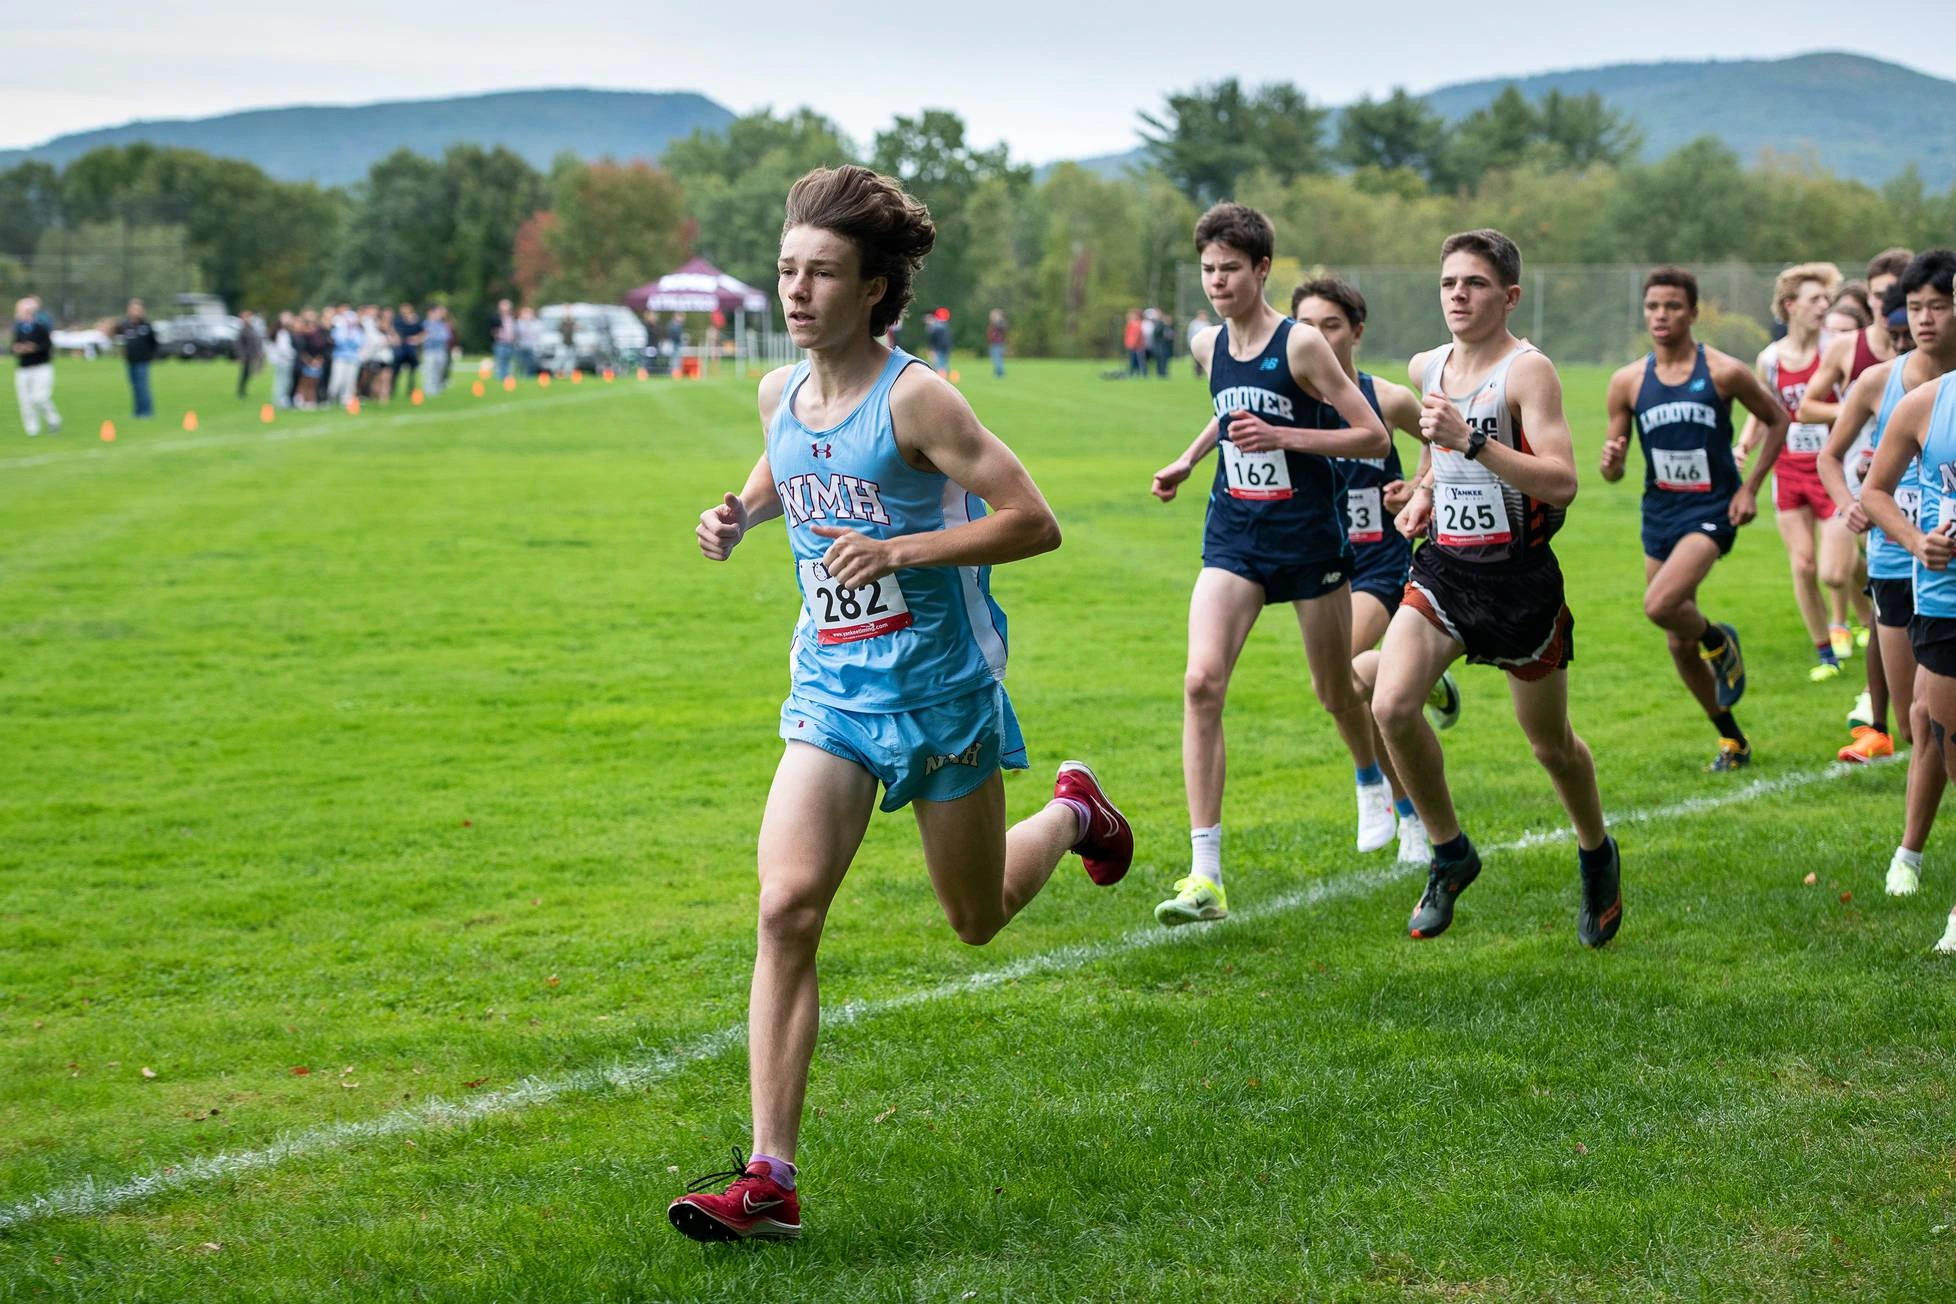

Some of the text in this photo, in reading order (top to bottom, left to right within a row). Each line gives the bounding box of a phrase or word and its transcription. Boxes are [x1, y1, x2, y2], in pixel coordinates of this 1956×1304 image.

[1235, 462, 1279, 486] 162
[1664, 464, 1701, 480] 146
[779, 473, 891, 528] NMH
[1451, 488, 1483, 500] YANKEE
[1444, 504, 1496, 531] 265
[816, 580, 889, 623] 282
[925, 743, 981, 776] NH
